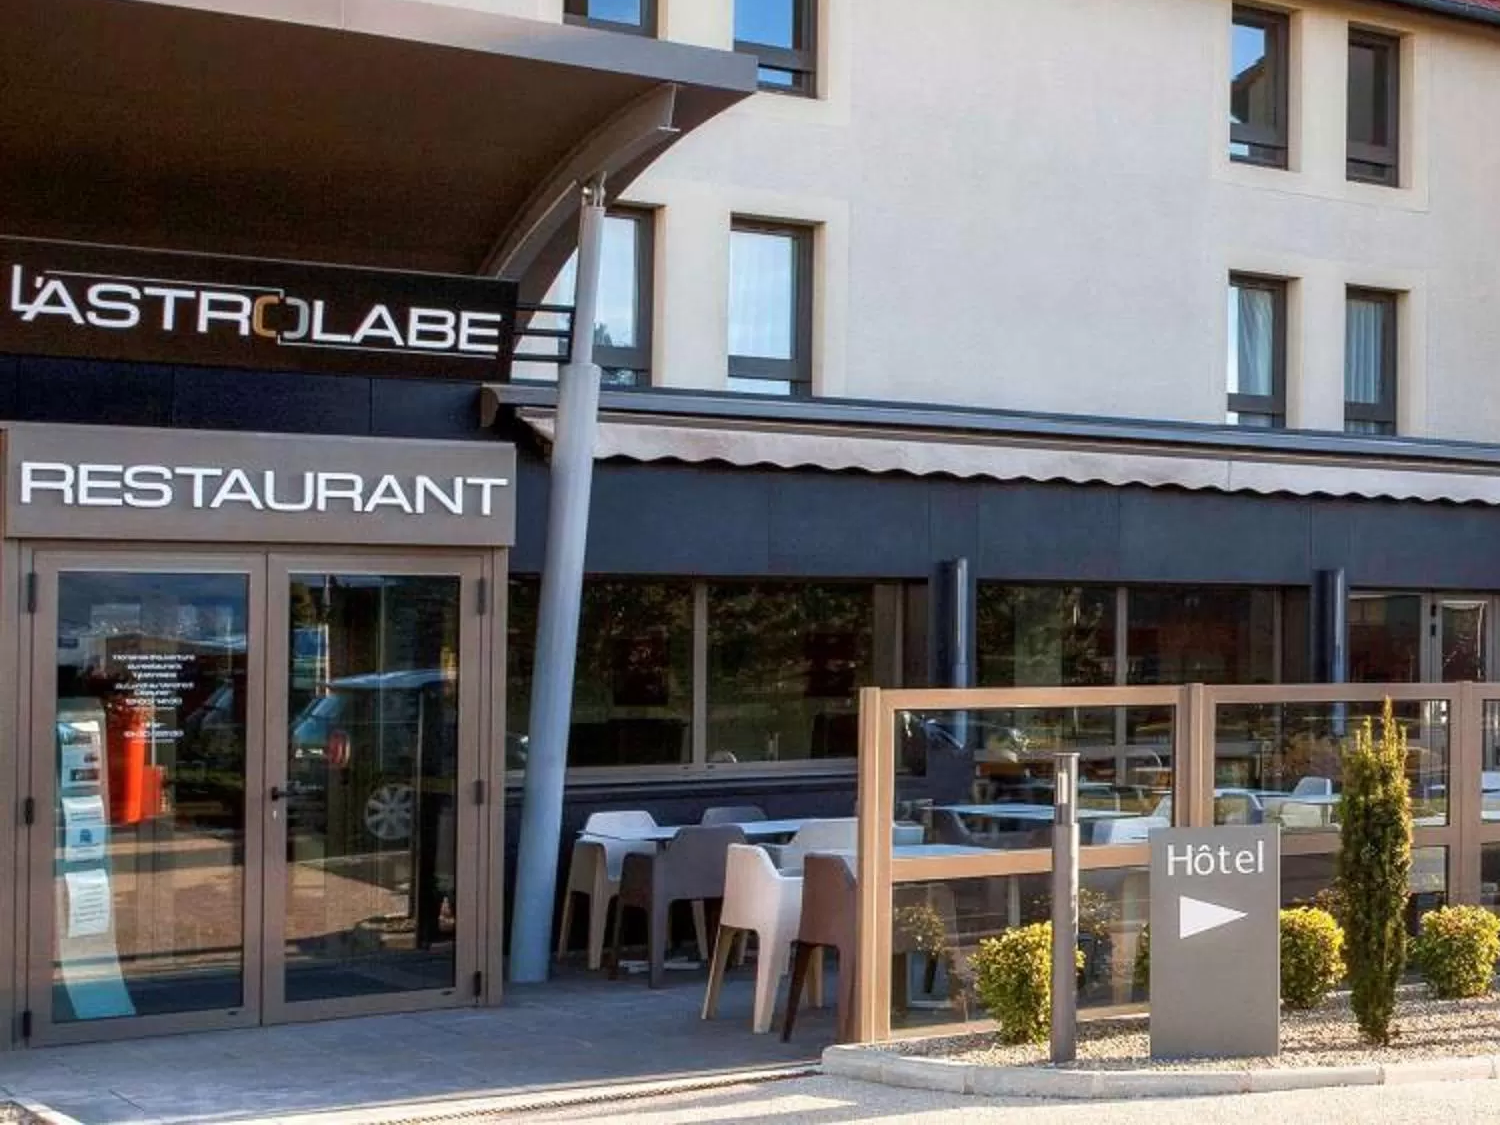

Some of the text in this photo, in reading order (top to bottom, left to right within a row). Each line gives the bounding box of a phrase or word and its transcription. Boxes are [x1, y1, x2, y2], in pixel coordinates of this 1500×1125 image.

[10, 263, 503, 353] L'ASTROLABE
[19, 461, 509, 517] RESTAURANT
[1167, 840, 1265, 876] Hôtel
